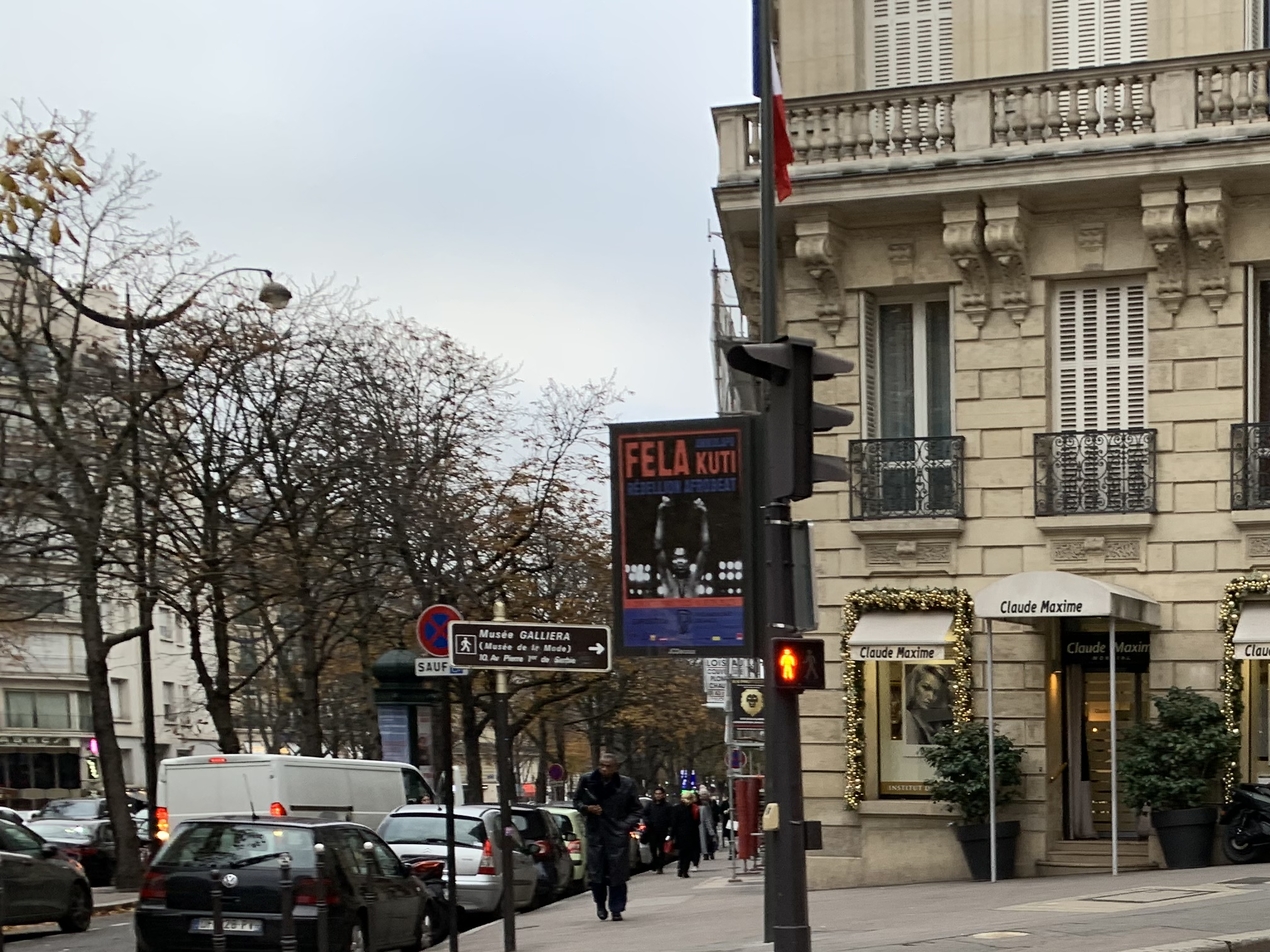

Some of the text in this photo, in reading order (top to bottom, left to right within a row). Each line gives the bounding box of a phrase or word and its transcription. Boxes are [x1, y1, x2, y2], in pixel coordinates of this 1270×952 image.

[625, 439, 690, 478] FELA
[696, 450, 737, 474] KUTI
[1000, 601, 1082, 613] Claude Maxime
[479, 629, 571, 641] Musée GALLIERA
[479, 641, 513, 651] (Musée
[517, 643, 528, 651] de
[1067, 641, 1150, 654] Claude Maxim
[859, 647, 934, 659] Claude Maxime
[418, 662, 448, 673] SAUF
